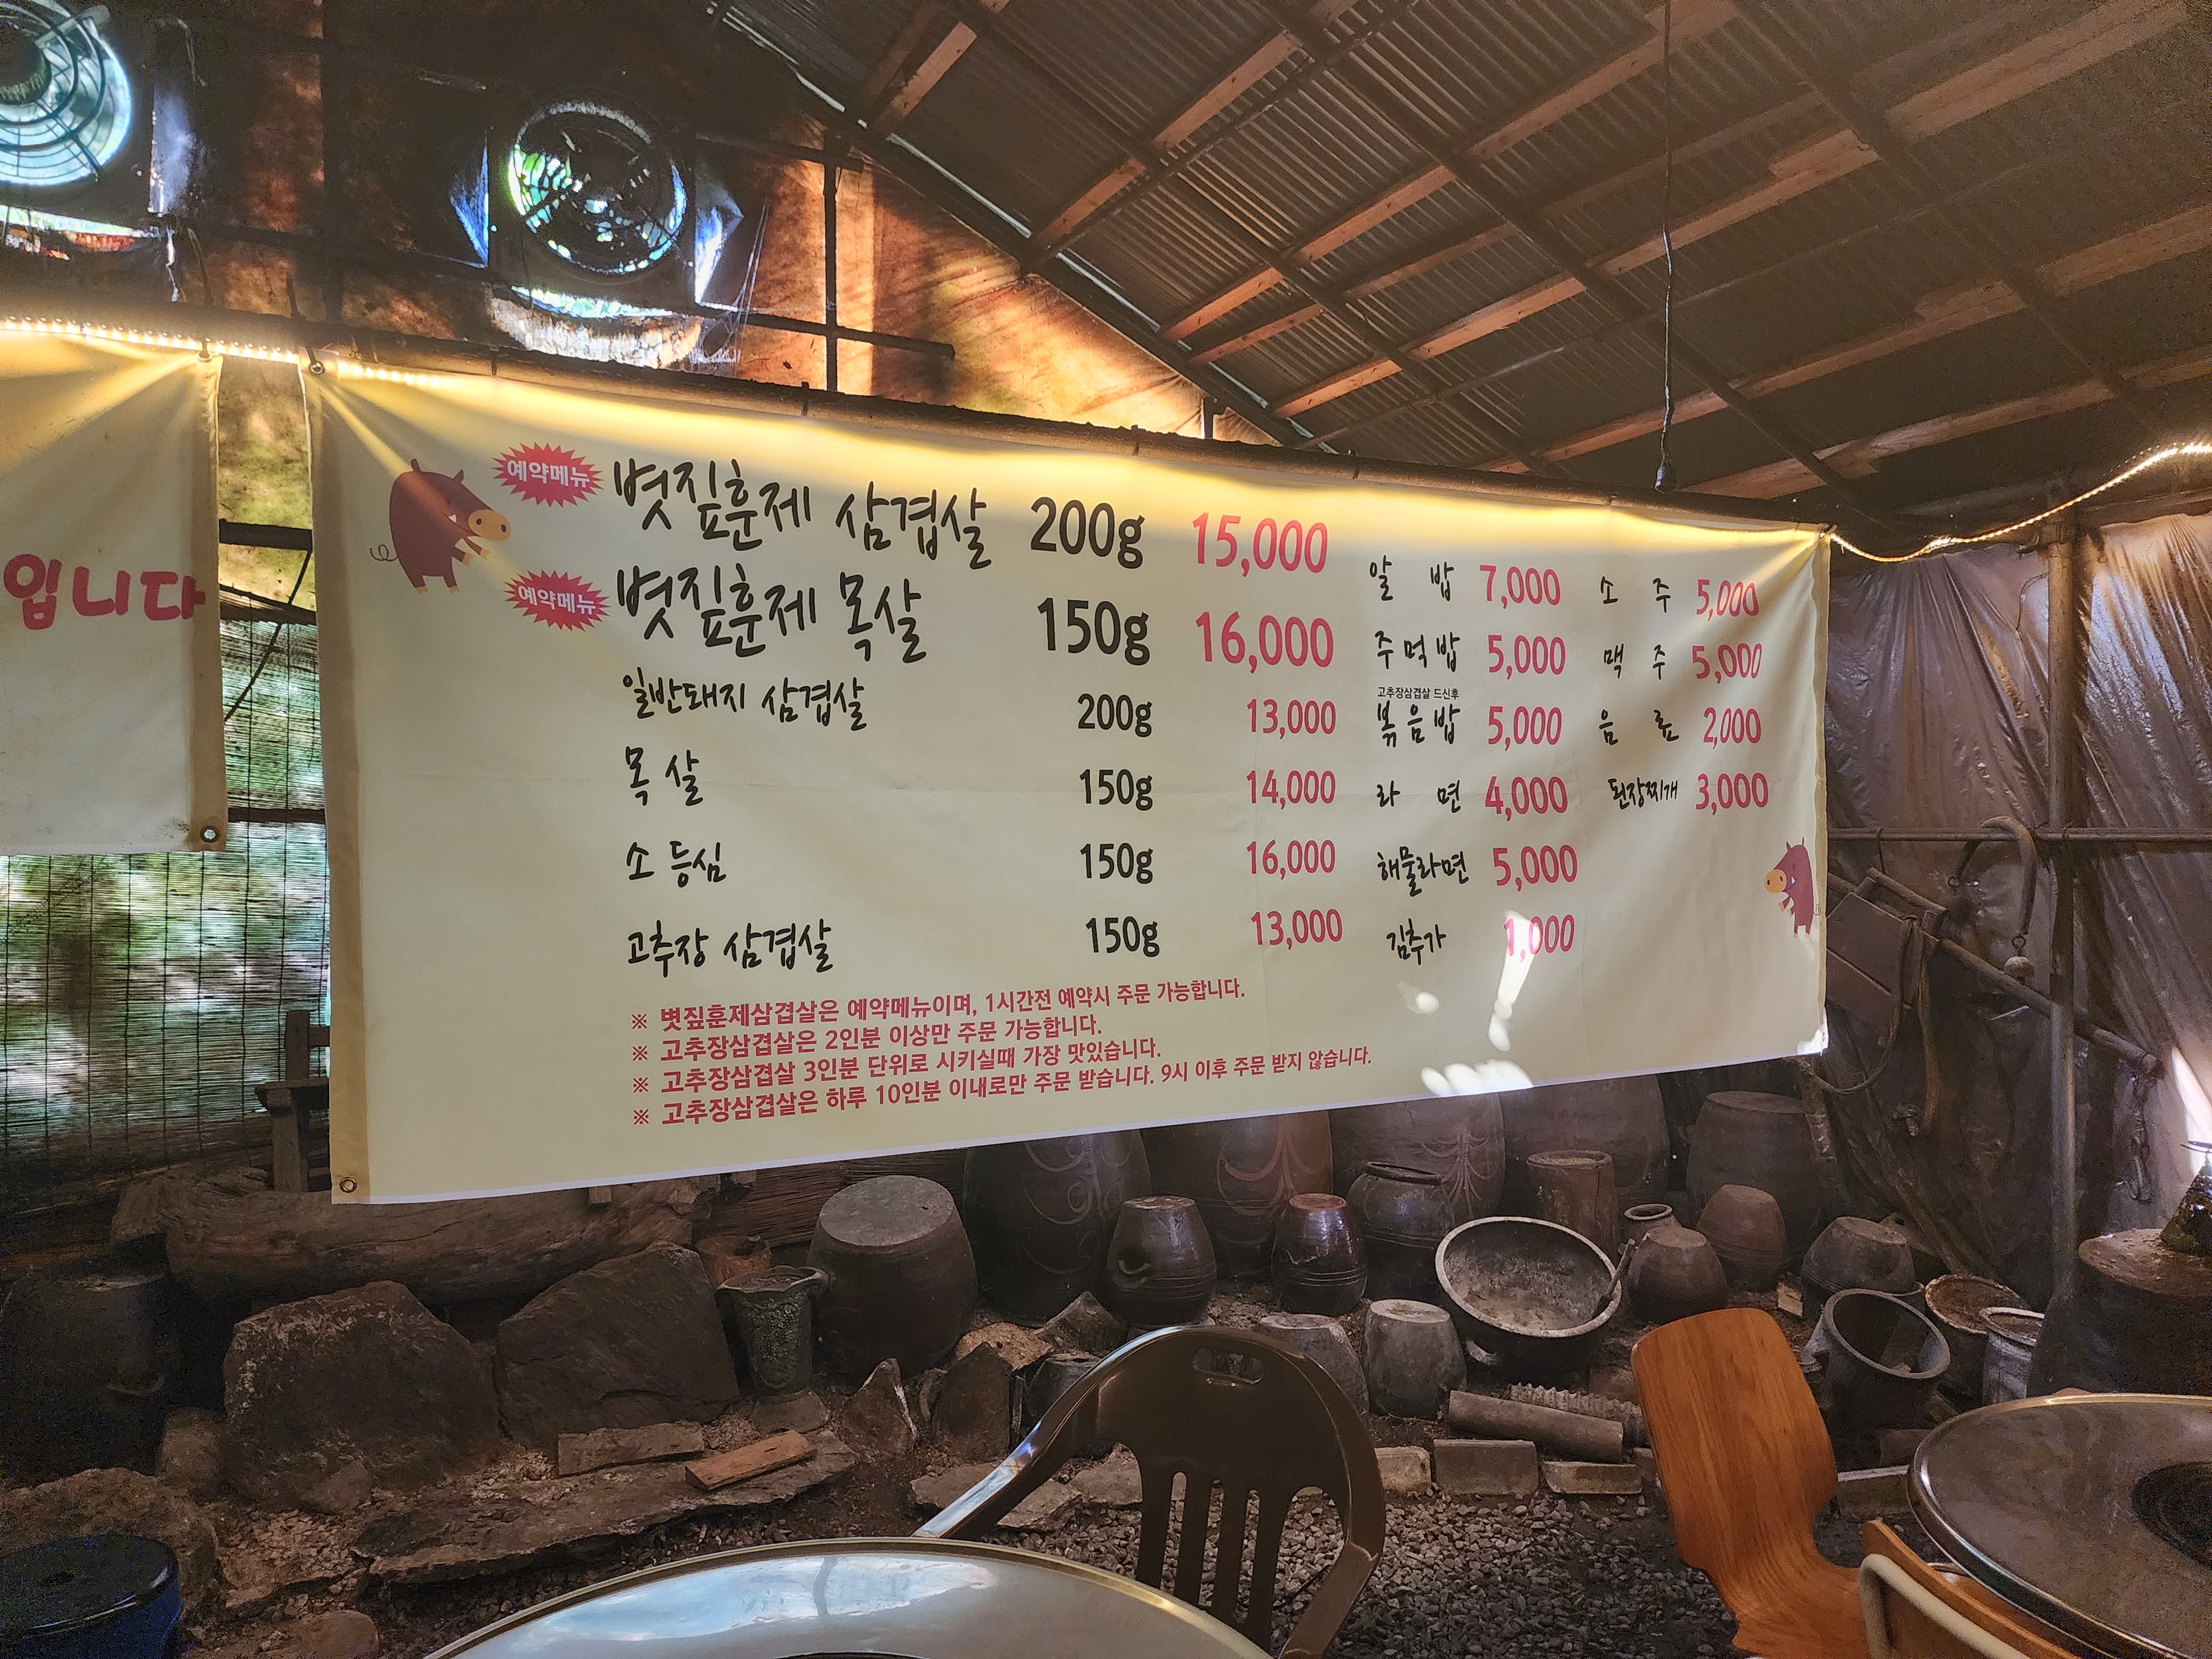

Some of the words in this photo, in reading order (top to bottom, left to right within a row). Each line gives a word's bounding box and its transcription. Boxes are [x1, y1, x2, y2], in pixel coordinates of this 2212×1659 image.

[507, 458, 590, 488] 예약메뉴
[614, 458, 811, 551] 볏짚훈제
[836, 481, 992, 570] 삼겹살
[1031, 497, 1145, 569] 200g
[1193, 514, 1327, 577] 15,000
[3, 554, 206, 630] 입니다
[518, 586, 597, 614] 예약메뉴
[1480, 565, 1560, 609] 7,000
[1697, 580, 1760, 620] 5,000
[617, 563, 816, 658] 볏짚훈제
[840, 572, 926, 663] 목살
[1037, 598, 1150, 665] 150g
[1196, 612, 1333, 674] 16,000
[1488, 635, 1566, 680] 5,000
[1692, 644, 1761, 684] 5,000
[623, 667, 745, 719] 일반돼지
[761, 677, 867, 731] 삼겹살
[1078, 693, 1152, 737] 200g
[1247, 699, 1335, 739] 13,000
[1378, 687, 1430, 699] 고추장삼겹살
[1434, 688, 1459, 700] 드신후
[1489, 706, 1562, 751] 5,000
[1704, 707, 1761, 749] 2,000
[1079, 769, 1152, 811] 150g
[1246, 770, 1335, 810] 14,000
[1485, 776, 1567, 821] 4,000
[1608, 777, 1677, 810] 된장찌개
[1696, 773, 1768, 815] 3,000
[670, 841, 726, 888] 등심
[1080, 843, 1153, 884] 150g
[1246, 839, 1335, 880] 16,000
[1378, 846, 1469, 897] 해물라면
[1493, 845, 1577, 891] 5,000
[628, 920, 709, 978] 고추장
[723, 919, 833, 973] 삼겹살
[1086, 916, 1160, 957] 150g
[1251, 909, 1342, 950] 13,000
[1386, 918, 1446, 966] 김추가
[1502, 914, 1575, 963] 1,000
[661, 1000, 839, 1032] 볏짚훈제삼겹살은
[848, 994, 977, 1020] 예약메뉴이며,
[986, 989, 1051, 1013] 1시간전
[1058, 986, 1109, 1009] 예약시
[1117, 984, 1150, 1005] 주문
[1157, 978, 1244, 1002] 가능합니다.
[661, 1030, 817, 1061] 고추장삼겹살은
[826, 1027, 880, 1050] 2인분
[890, 1024, 950, 1047] 이상만
[958, 1021, 997, 1044] 주문
[1005, 1014, 1101, 1040] 가능합니다.
[661, 1062, 795, 1093] 고추장삼겹살
[804, 1057, 859, 1081] 3인분
[869, 1054, 928, 1077] 단위로
[936, 1047, 1015, 1072] 시키실때
[1023, 1045, 1061, 1066] 가장
[1068, 1037, 1161, 1064] 맛있습니다.
[662, 1091, 818, 1124] 고추장삼겹살은
[826, 1087, 867, 1110] 하루
[876, 1081, 941, 1104] 10인분
[950, 1074, 1027, 1098] 이내로만
[1034, 1072, 1071, 1093] 주문
[1079, 1065, 1154, 1089] 받습니다.
[1161, 1062, 1187, 1082] 9시
[1196, 1058, 1227, 1079] 이후
[1234, 1056, 1265, 1077] 주문
[1272, 1052, 1301, 1073] 받지
[1308, 1046, 1371, 1070] 않습니다.
